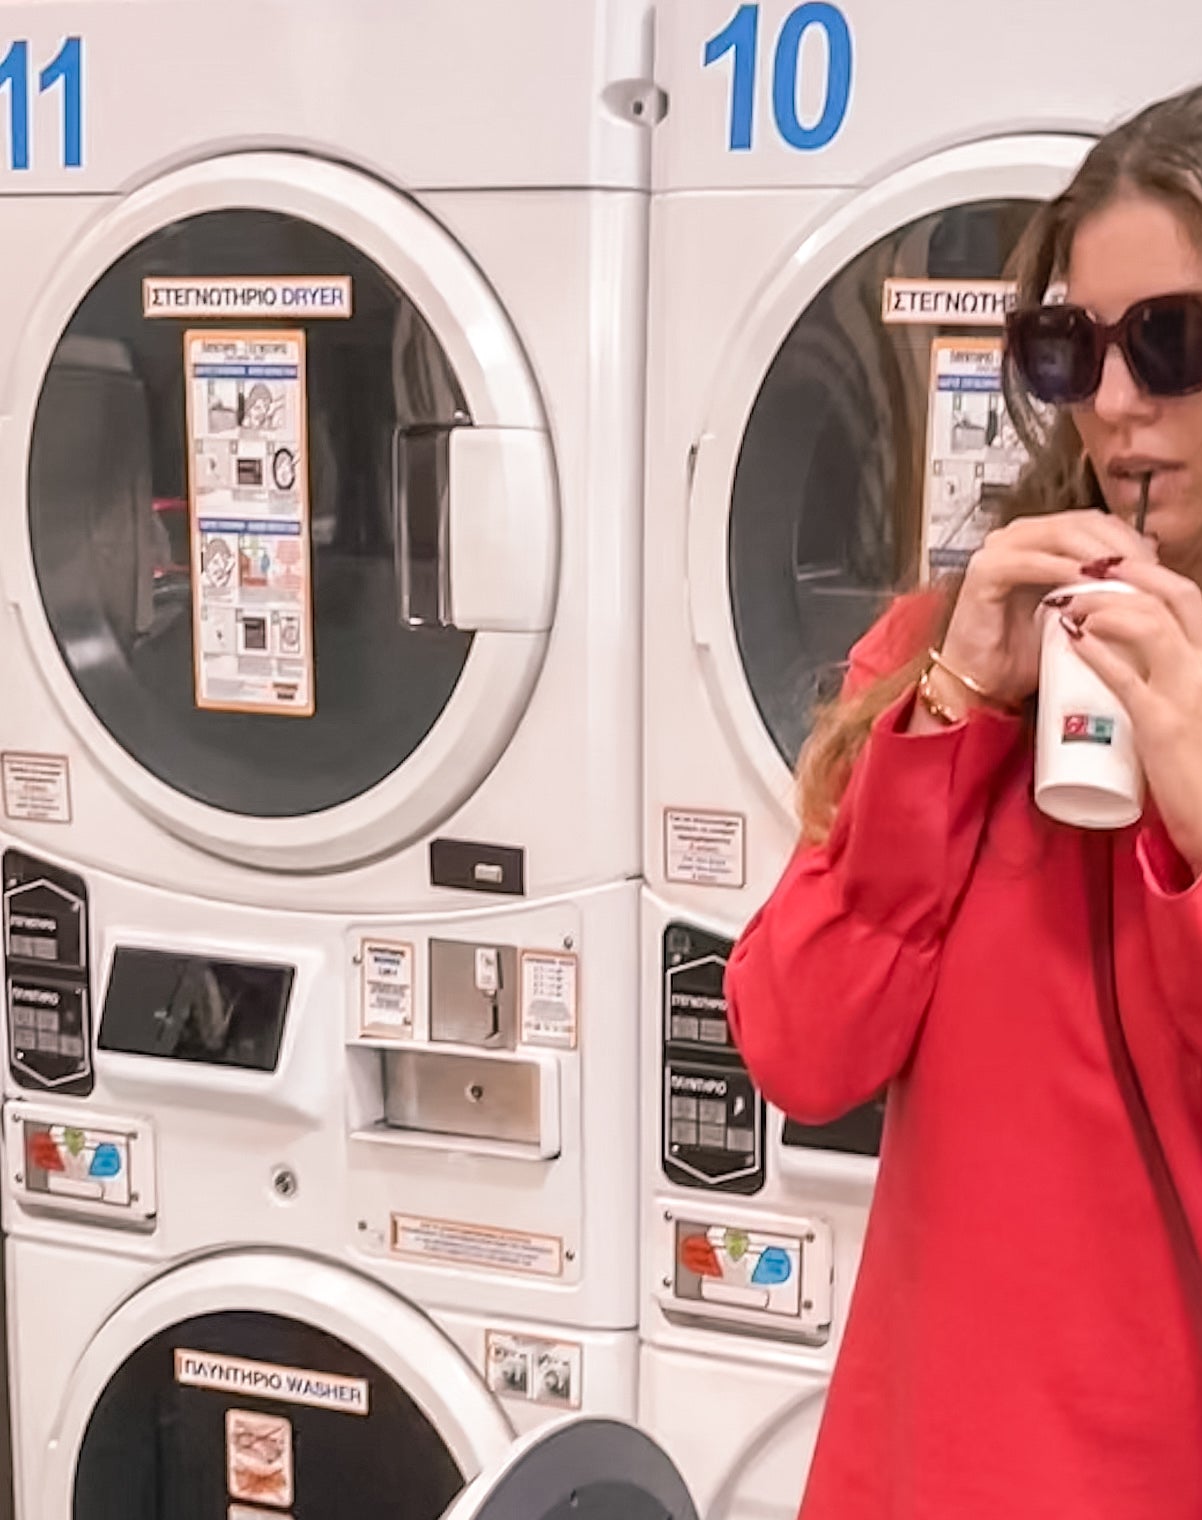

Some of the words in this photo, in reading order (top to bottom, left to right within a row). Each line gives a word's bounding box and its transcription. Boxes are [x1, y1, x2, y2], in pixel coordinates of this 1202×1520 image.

[704, 1, 853, 152] 10
[0, 36, 82, 170] 11
[152, 287, 277, 306] ΣΤΕΓΝΩΤΗΡΙΟ
[282, 287, 344, 306] DRYER
[894, 291, 1018, 313] ΣΤΕΓΝΩΤΗ
[184, 1358, 282, 1391] ΠΛΥΝΤΗΡΙΟ
[286, 1376, 362, 1405] WASHER
